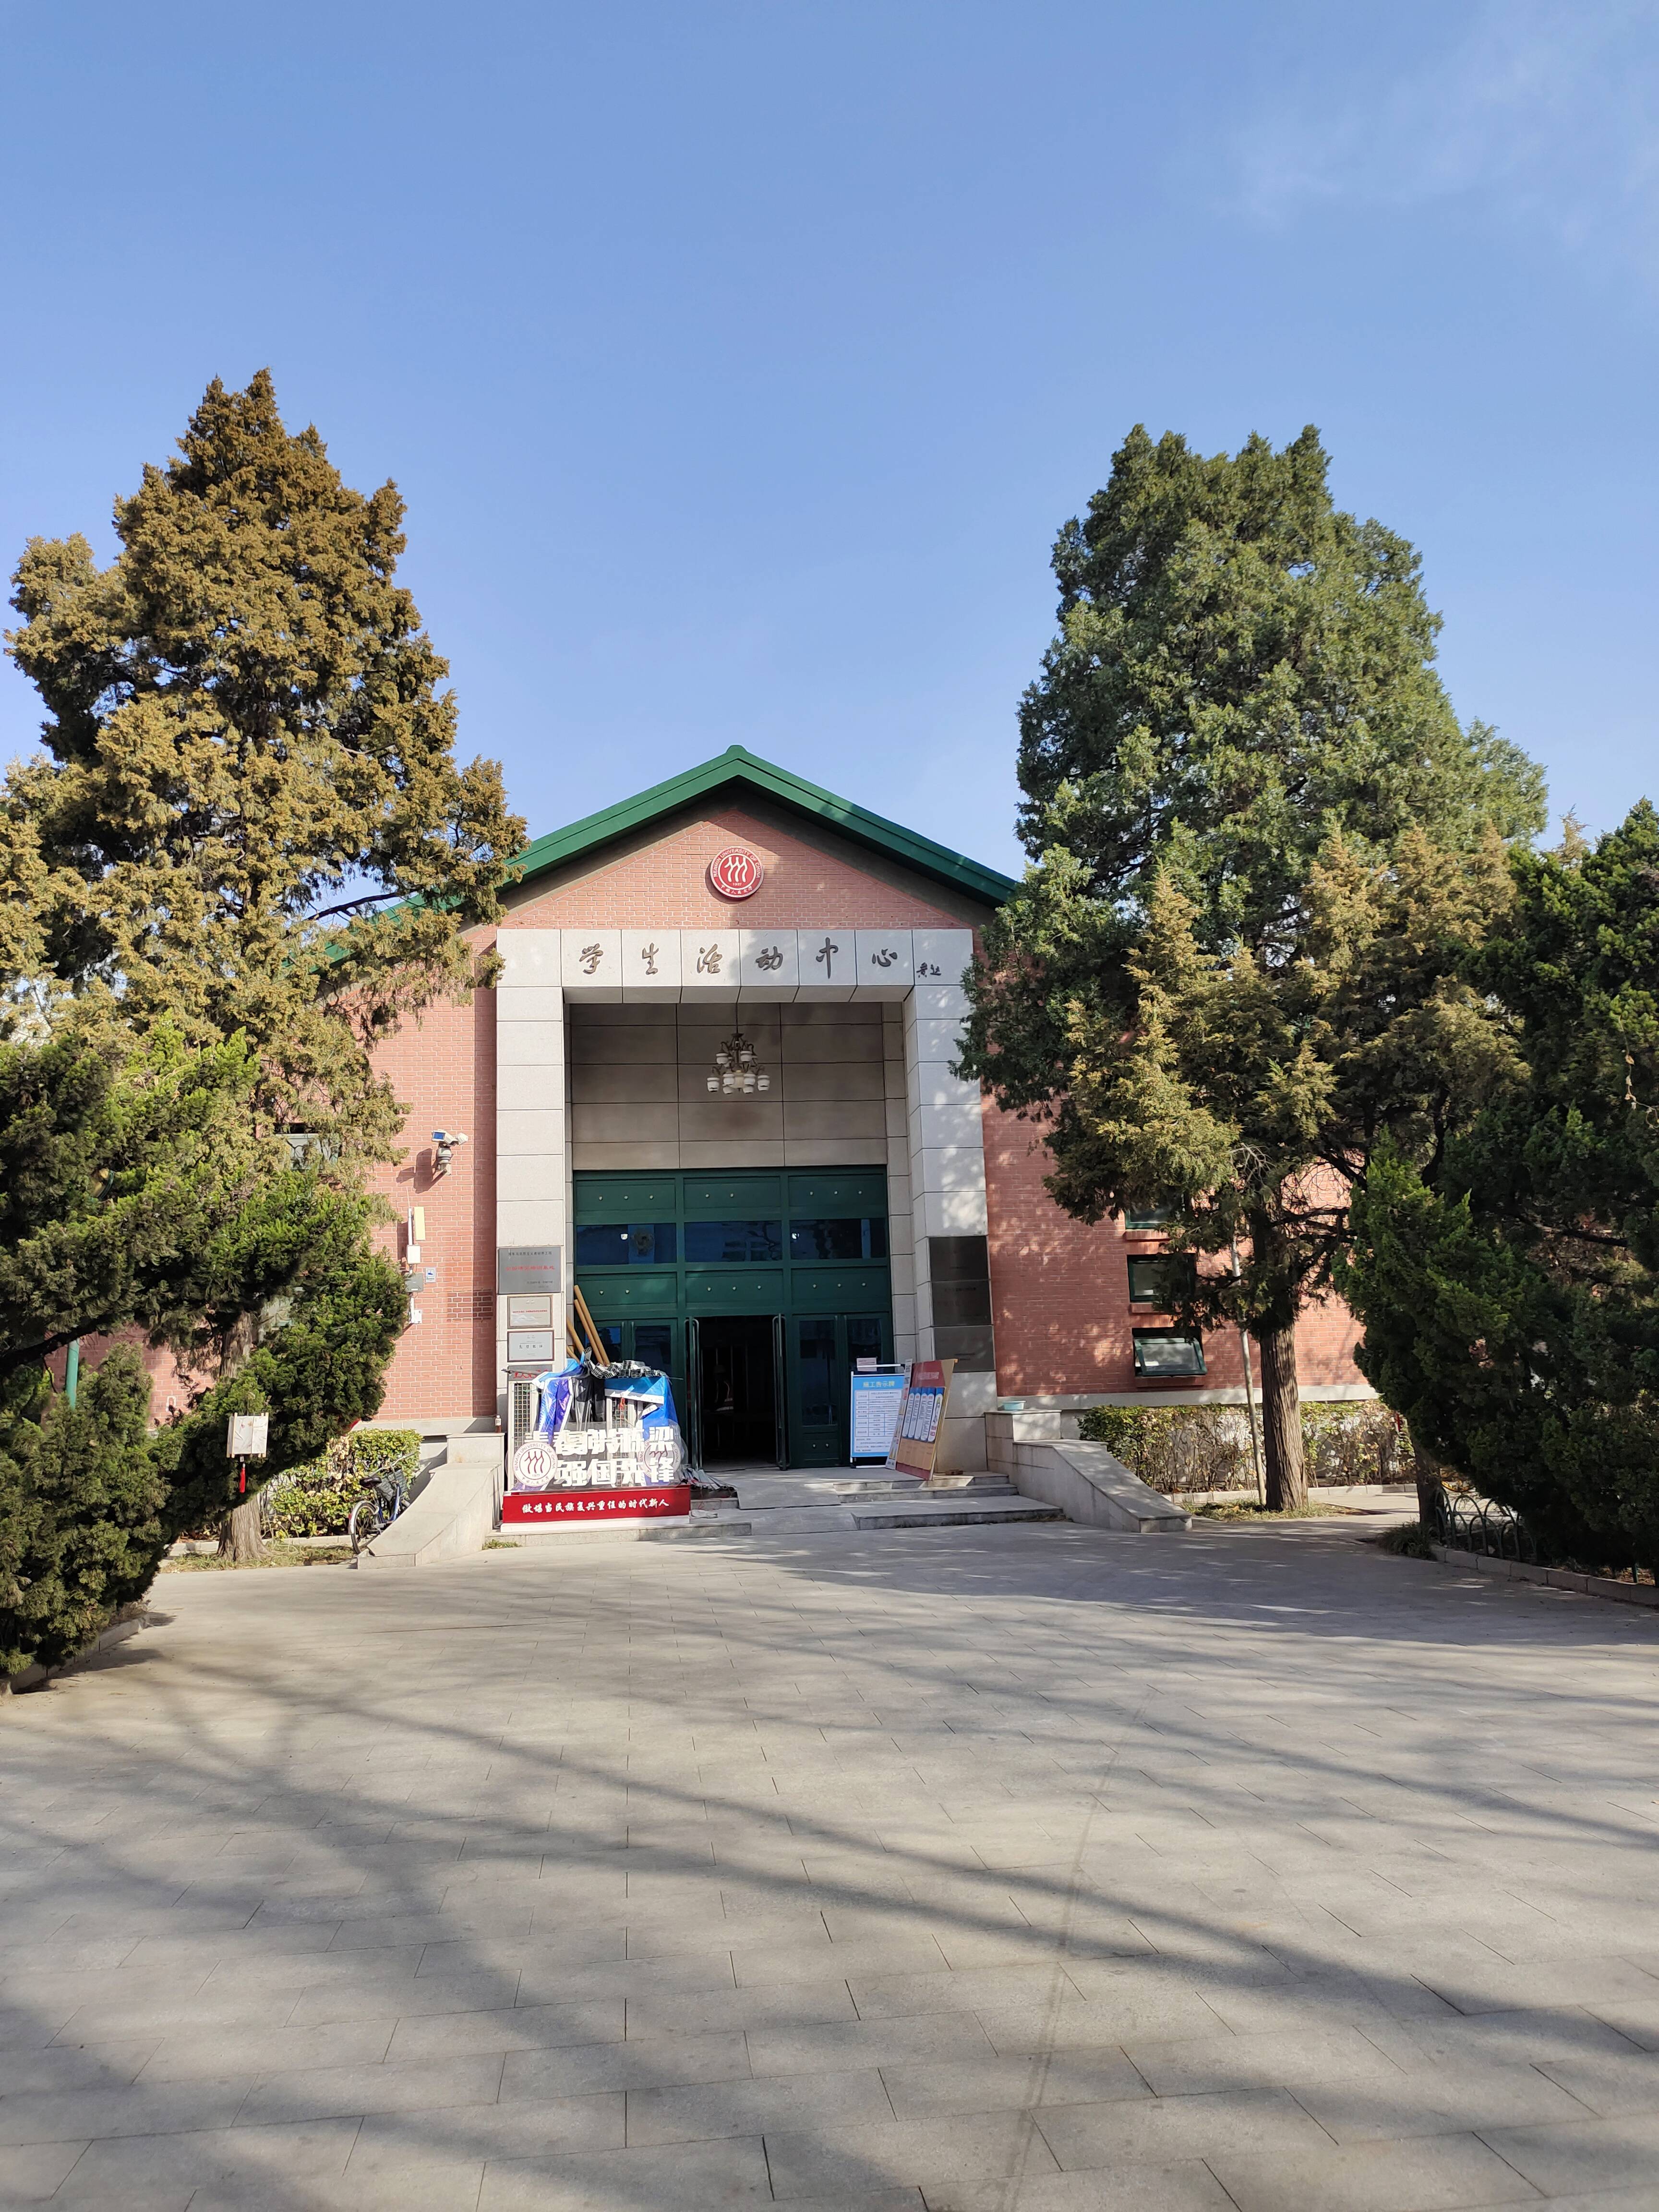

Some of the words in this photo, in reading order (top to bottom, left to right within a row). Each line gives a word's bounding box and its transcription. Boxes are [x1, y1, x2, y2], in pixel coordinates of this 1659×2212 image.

[720, 848, 750, 858] UNIVERSITY
[579, 937, 898, 979] 学生活动中心
[520, 1443, 546, 1453] UNIVERSITY
